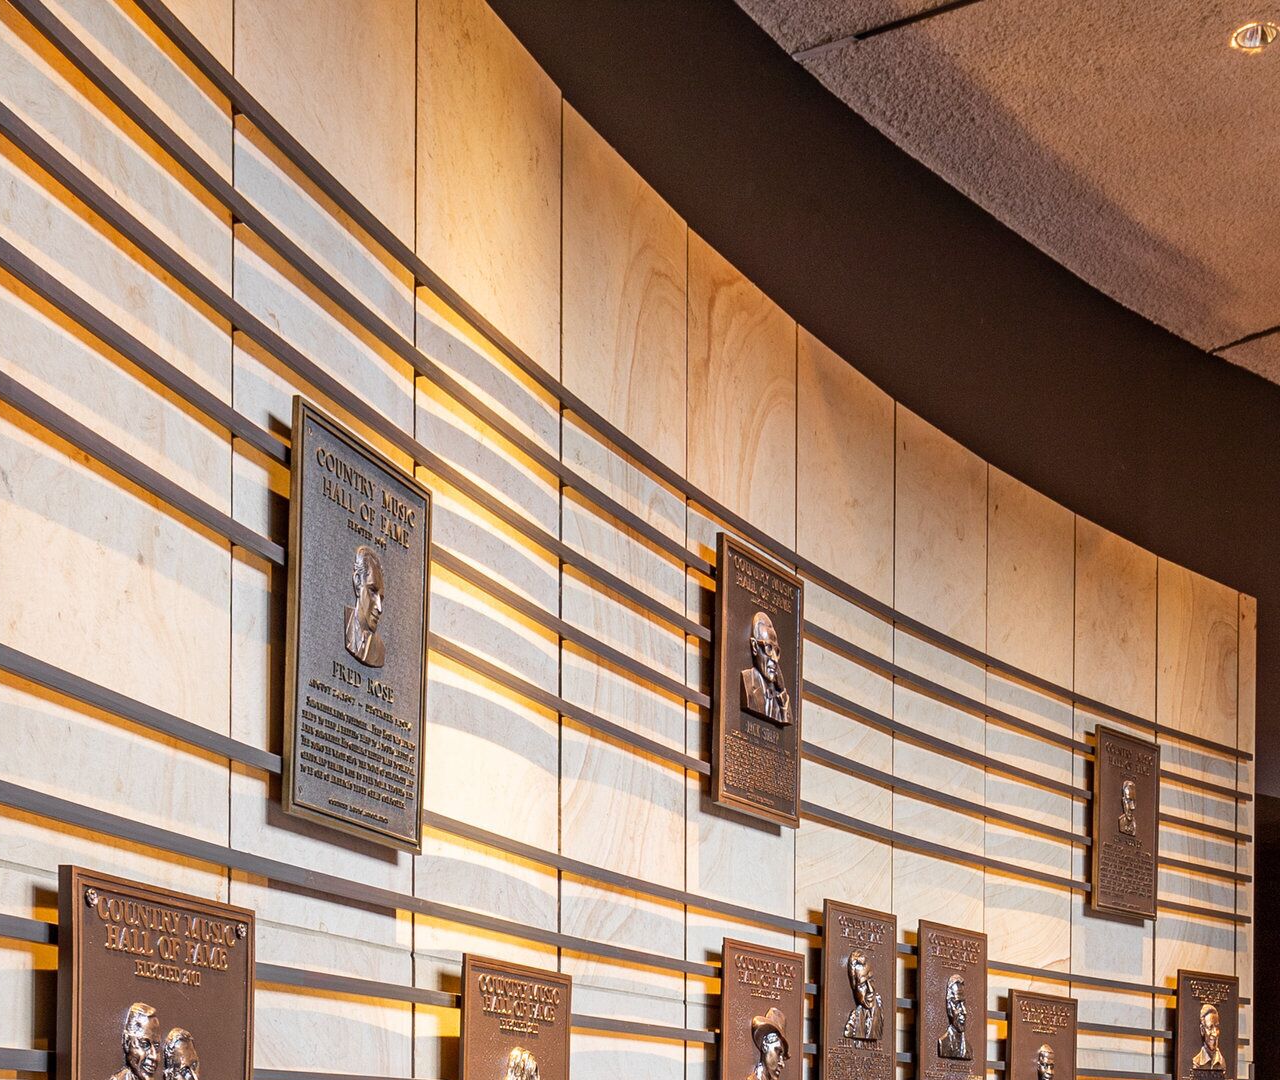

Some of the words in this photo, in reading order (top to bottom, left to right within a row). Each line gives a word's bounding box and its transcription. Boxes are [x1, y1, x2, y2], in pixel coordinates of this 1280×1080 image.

[316, 447, 376, 501] COUNTRY
[381, 490, 415, 528] MUSIC
[322, 476, 355, 514] HALL
[359, 502, 376, 526] OF
[380, 514, 410, 550] FAME
[332, 660, 362, 689] FRED
[367, 678, 395, 705] ROSE
[97, 895, 182, 935] COUNTRY
[184, 913, 237, 948] MUSIC
[105, 923, 154, 957] HALL
[157, 935, 183, 961] OF
[184, 941, 229, 971] FAME
